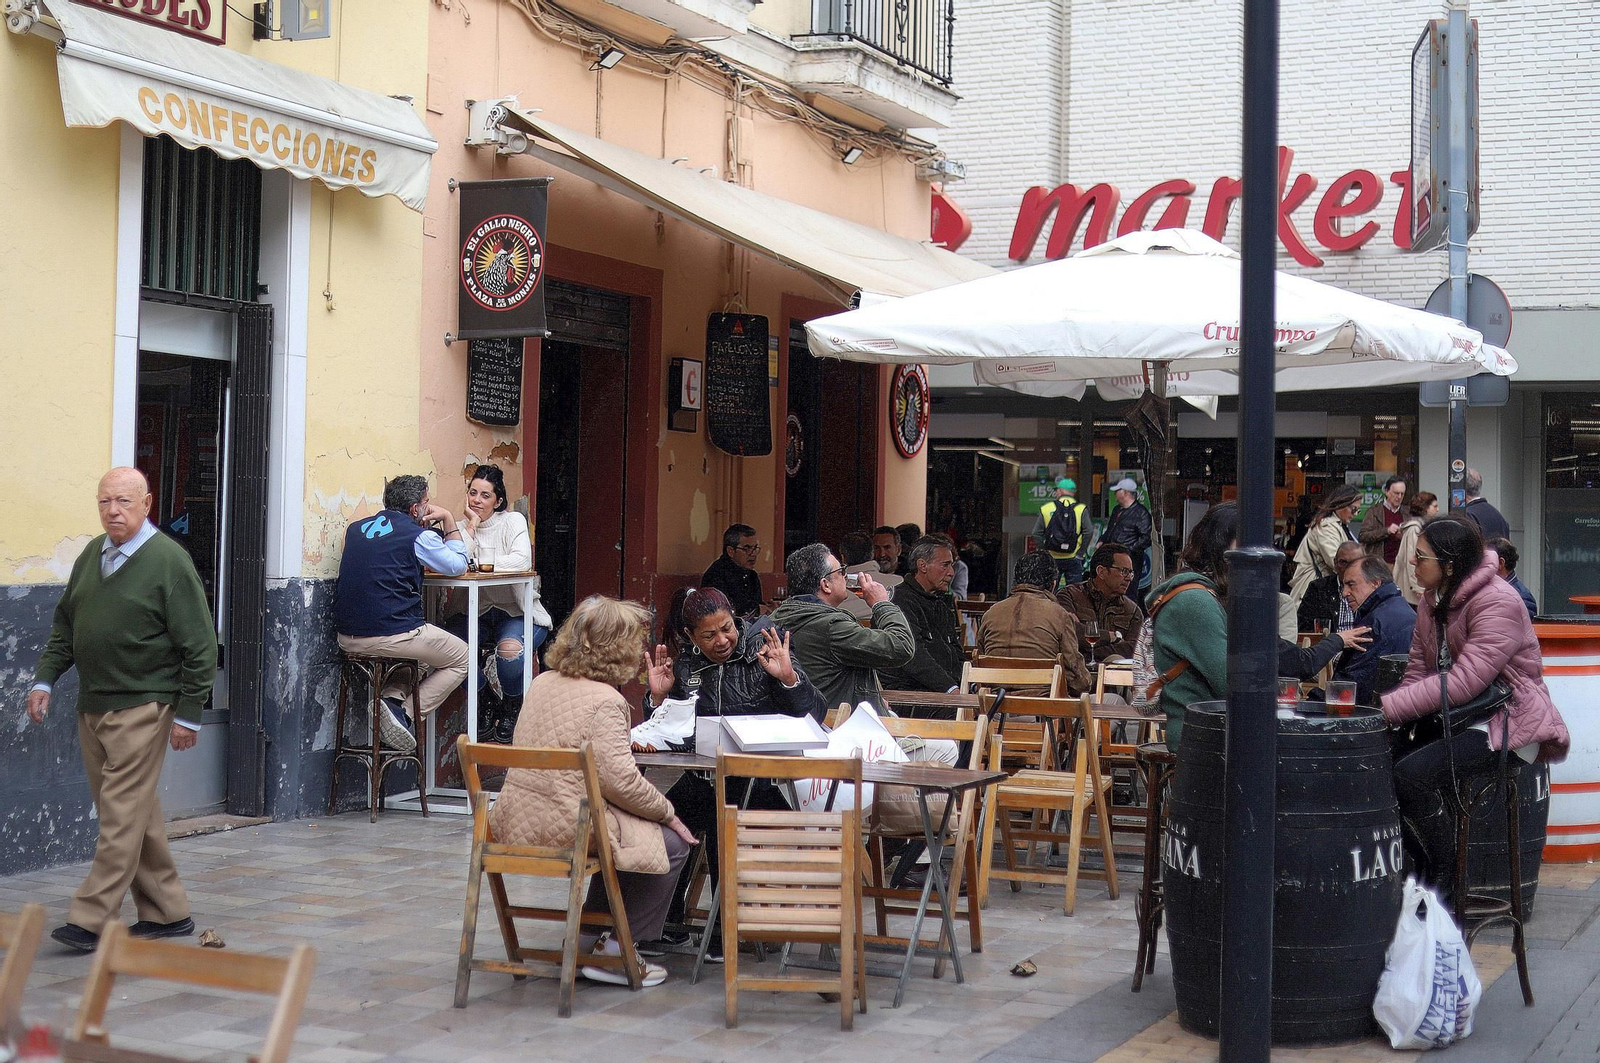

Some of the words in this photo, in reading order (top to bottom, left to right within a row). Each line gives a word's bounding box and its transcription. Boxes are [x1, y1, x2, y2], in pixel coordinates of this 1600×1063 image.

[138, 86, 376, 182] CONFECCIONES
[467, 236, 480, 251] EL
[477, 218, 507, 237] GALLO
[508, 218, 537, 246] NEGRO
[466, 277, 494, 307] PLAZA
[507, 272, 536, 305] MONJAS
[1203, 322, 1317, 344] Crumpo
